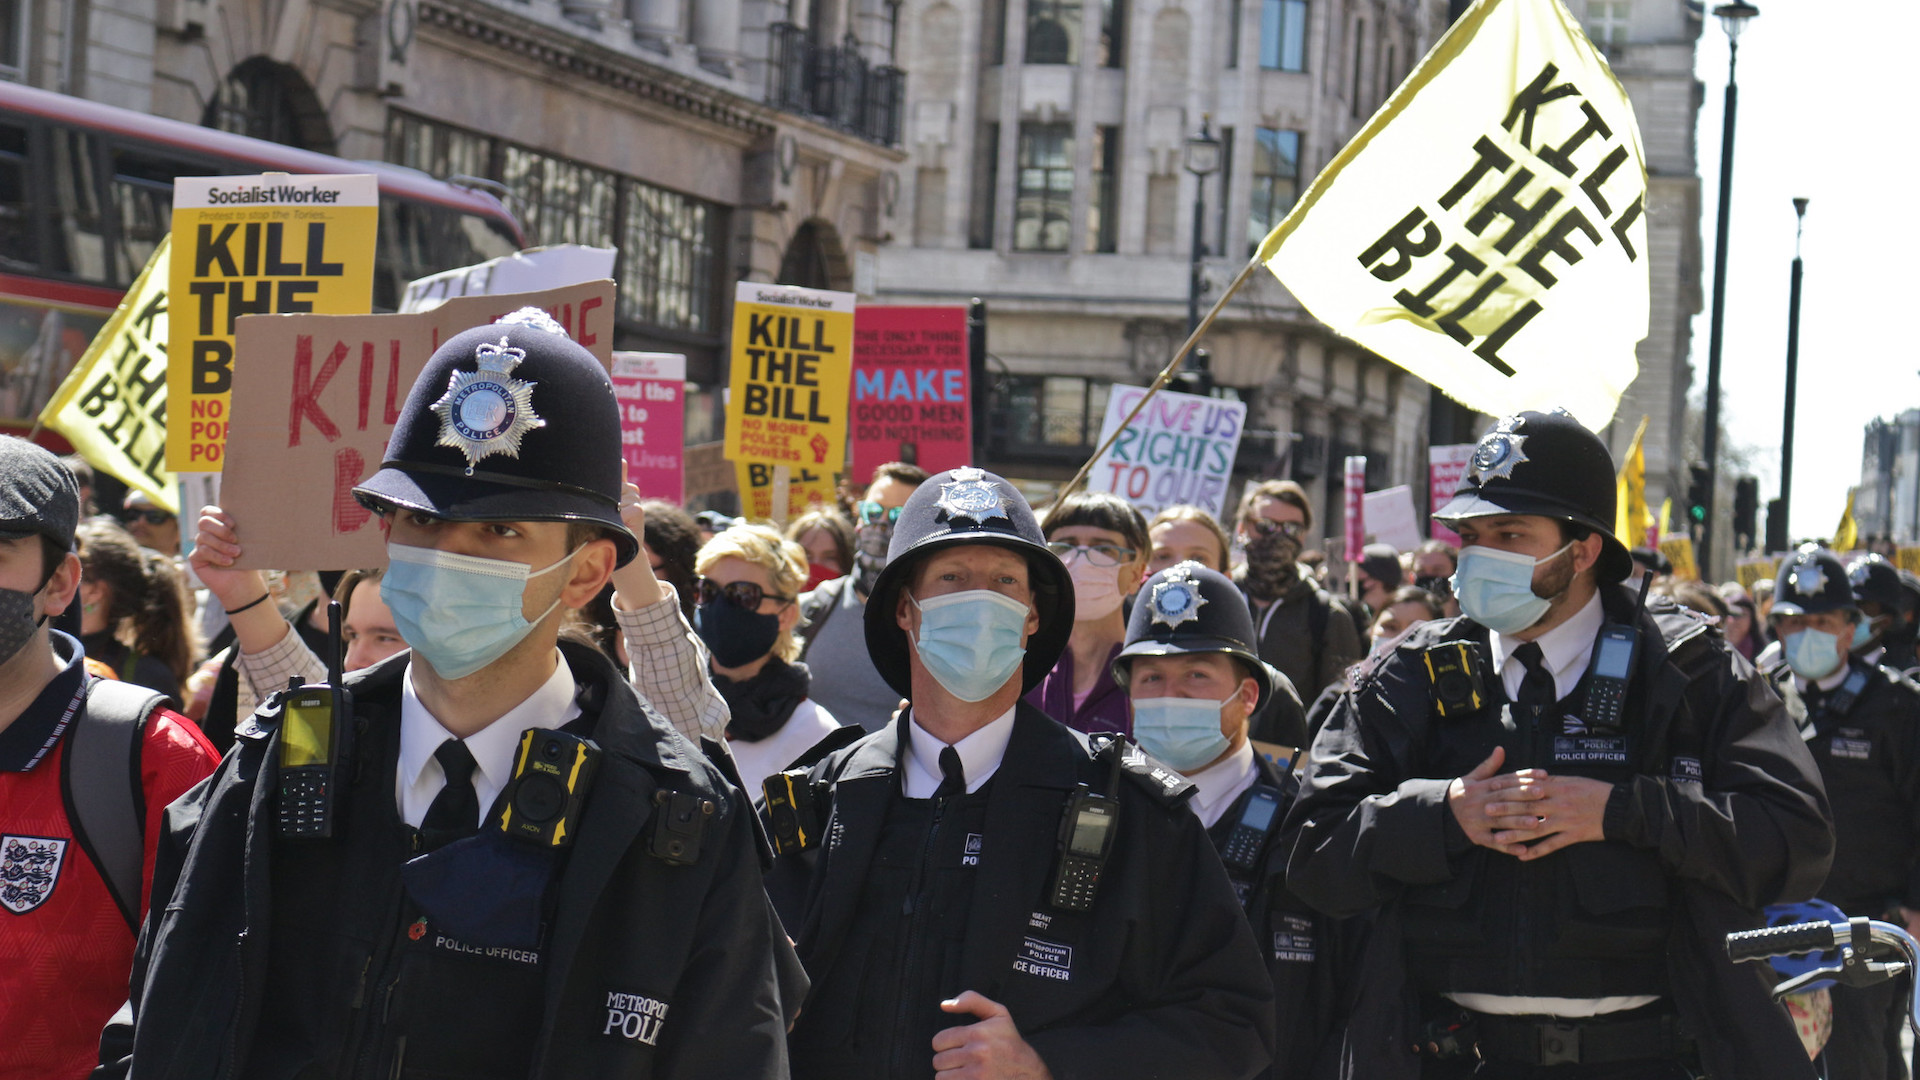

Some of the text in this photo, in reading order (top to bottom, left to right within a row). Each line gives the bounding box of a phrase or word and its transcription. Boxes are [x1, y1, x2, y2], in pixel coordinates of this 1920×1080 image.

[1500, 61, 1644, 263] KILL
[208, 185, 341, 204] Socialist Worker
[272, 210, 290, 220] the
[1437, 134, 1603, 290] THE
[194, 221, 344, 278] KILL
[1357, 205, 1544, 378] BILL
[189, 281, 319, 335] THE
[749, 313, 835, 353] KILL
[746, 348, 820, 387] THE
[454, 382, 516, 413] METROPOLITAN
[645, 381, 676, 402] the
[855, 368, 965, 402] MAKE
[191, 399, 223, 418] NO
[628, 404, 648, 423] to
[744, 383, 830, 424] BILL
[856, 404, 964, 422] GOOD MEN
[79, 372, 166, 489] BILL
[456, 421, 502, 439] POLICE
[741, 419, 809, 436] NO MORE
[856, 425, 965, 442] DO NOTHING
[1203, 404, 1241, 438] US
[740, 431, 791, 447] POLICE
[740, 444, 802, 461] POWERS
[1110, 426, 1233, 474] RIGHTS
[1108, 461, 1150, 499] TO
[1154, 469, 1223, 513] OUR
[1555, 752, 1625, 761] POLICE OFFICER
[435, 936, 538, 964] POLICE OFFICER
[1024, 941, 1066, 955] METROPOLITAN
[1029, 949, 1060, 961] POLICE
[1029, 964, 1070, 981] OFFICER
